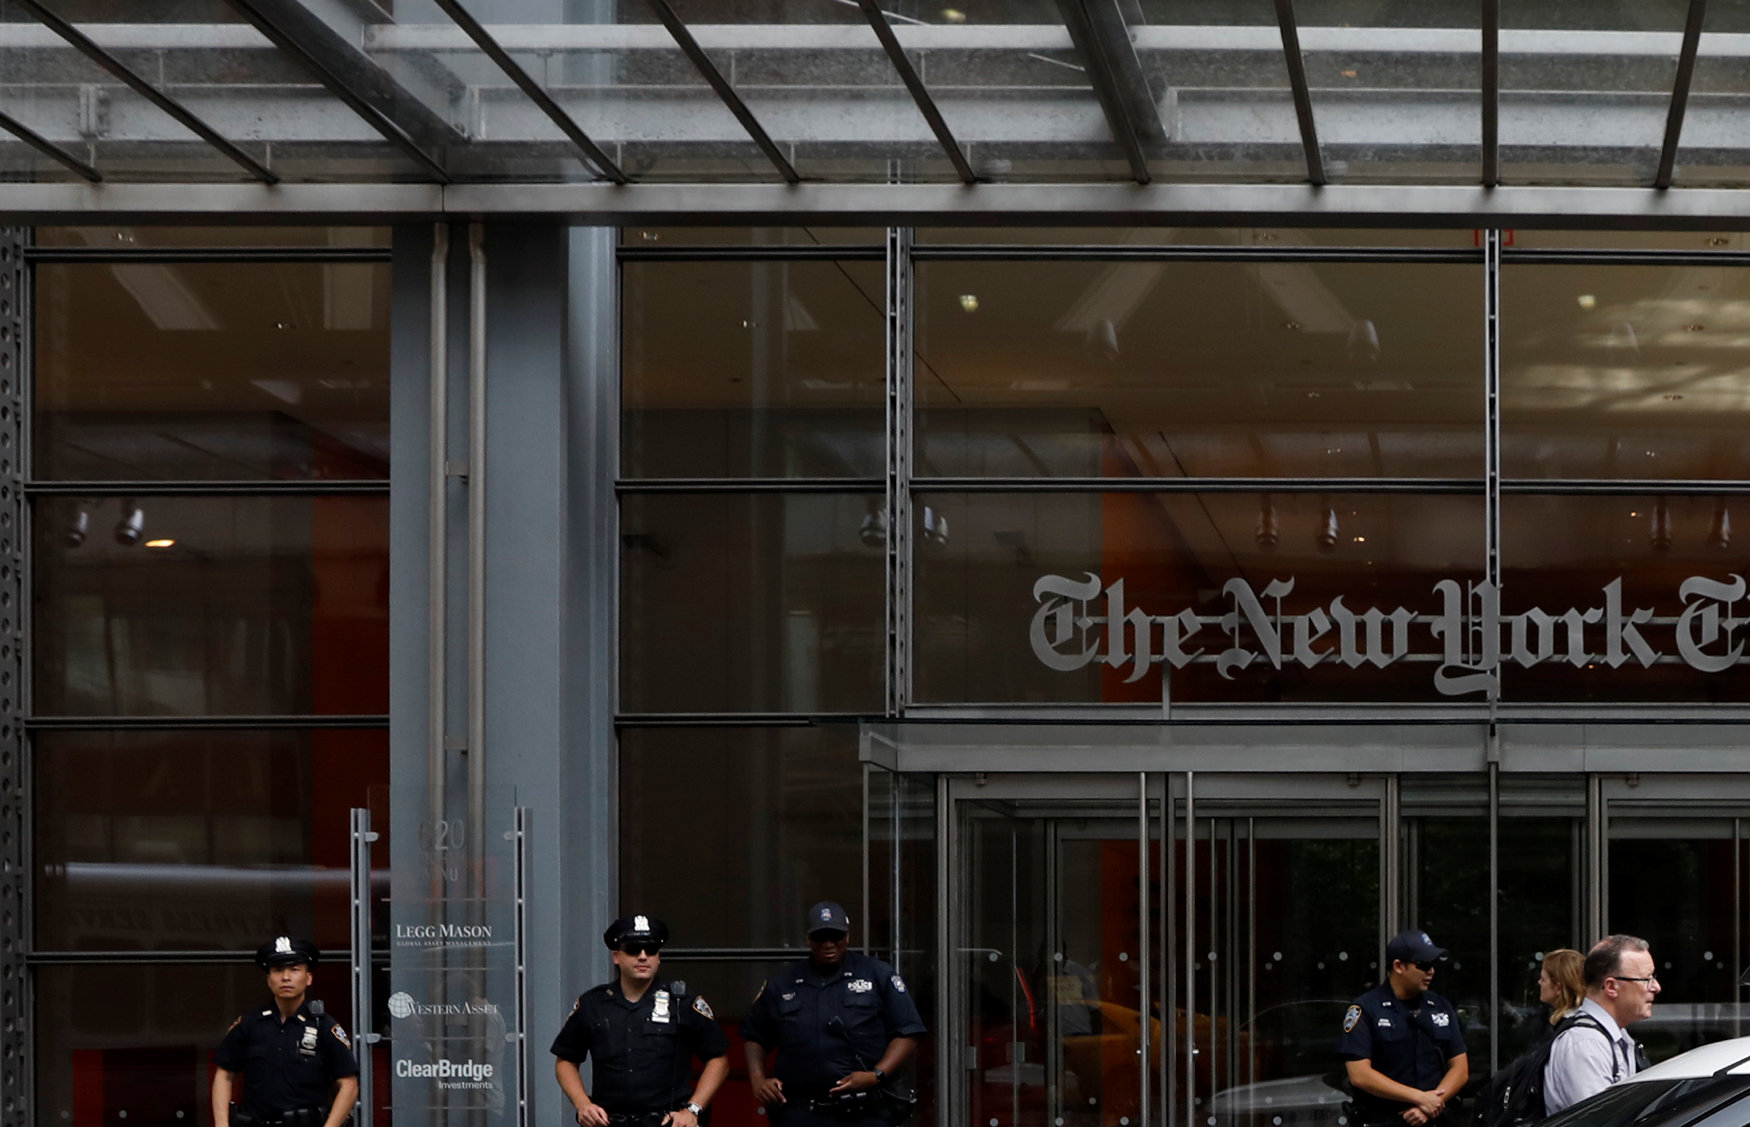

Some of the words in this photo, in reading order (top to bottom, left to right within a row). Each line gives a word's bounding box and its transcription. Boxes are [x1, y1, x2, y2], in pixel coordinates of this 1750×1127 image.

[1029, 571, 1204, 683] The
[1214, 574, 1417, 681] New
[1432, 574, 1661, 697] York
[396, 924, 436, 938] LEGG
[439, 924, 492, 938] MASON
[407, 1002, 460, 1015] WESTERN
[462, 1001, 498, 1015] ASSET
[396, 1059, 493, 1082] ClearBridge
[438, 1081, 494, 1089] Investments
